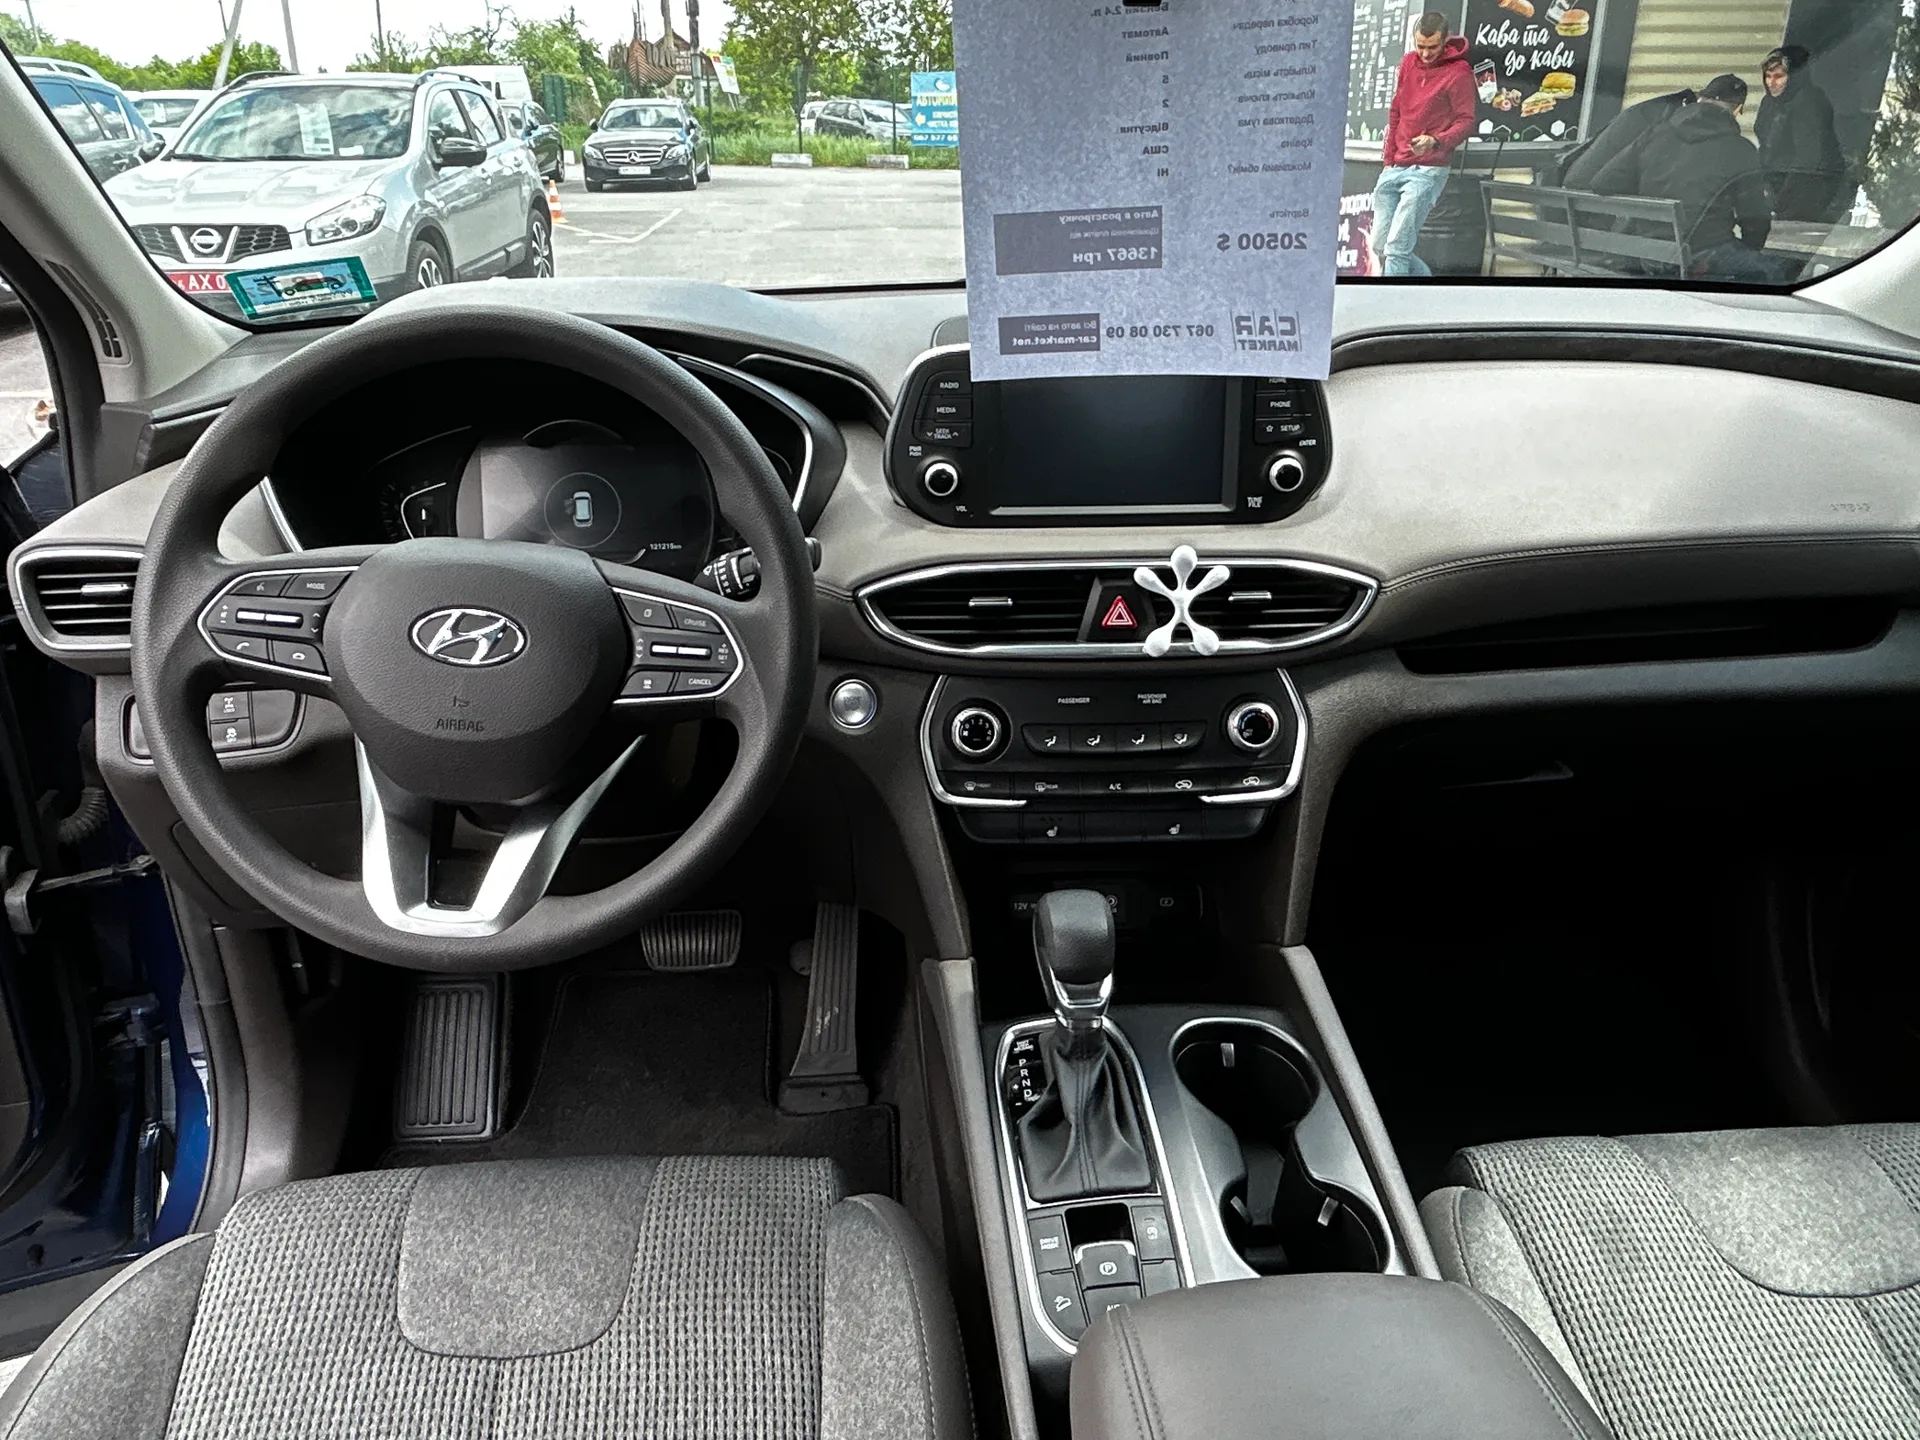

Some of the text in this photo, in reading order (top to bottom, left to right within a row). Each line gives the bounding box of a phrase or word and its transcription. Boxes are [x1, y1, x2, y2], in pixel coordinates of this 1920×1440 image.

[1475, 19, 1550, 48] Кава та
[1504, 41, 1575, 76] до кави
[1270, 400, 1291, 408] PHONE
[1280, 424, 1300, 432] SETUP
[306, 582, 325, 590] MODE
[684, 618, 707, 627] CRUISE
[688, 678, 712, 686] CANCEL
[434, 717, 485, 732] AIRBAG
[1013, 902, 1028, 910] 12V
[1019, 1058, 1027, 1067] P
[1020, 1068, 1029, 1077] R
[1022, 1078, 1031, 1087] N
[1023, 1088, 1033, 1100] D
